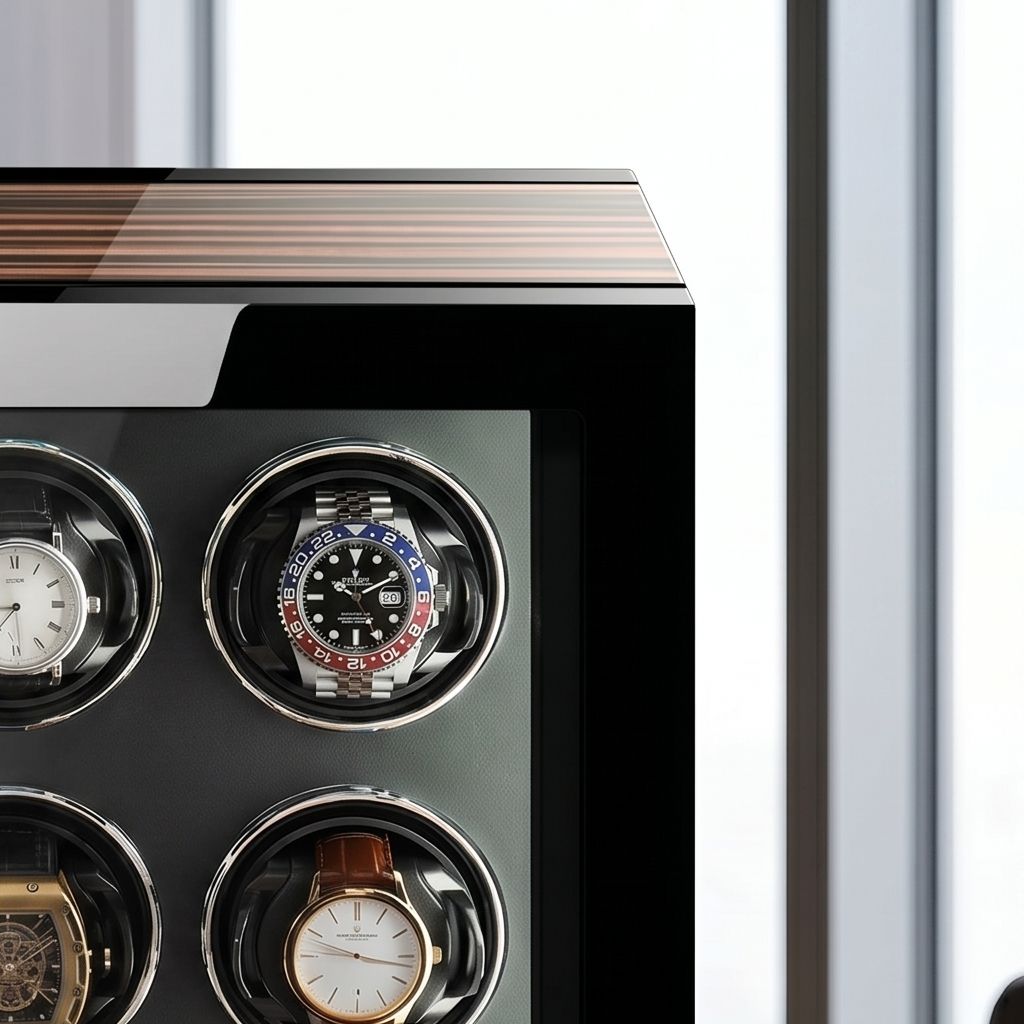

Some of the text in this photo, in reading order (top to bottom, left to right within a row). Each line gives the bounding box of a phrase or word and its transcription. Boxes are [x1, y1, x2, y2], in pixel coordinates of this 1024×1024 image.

[311, 530, 336, 550] 22
[381, 531, 397, 546] 2
[288, 552, 309, 577] 20
[381, 647, 401, 663] 10
[346, 658, 367, 670] 12
